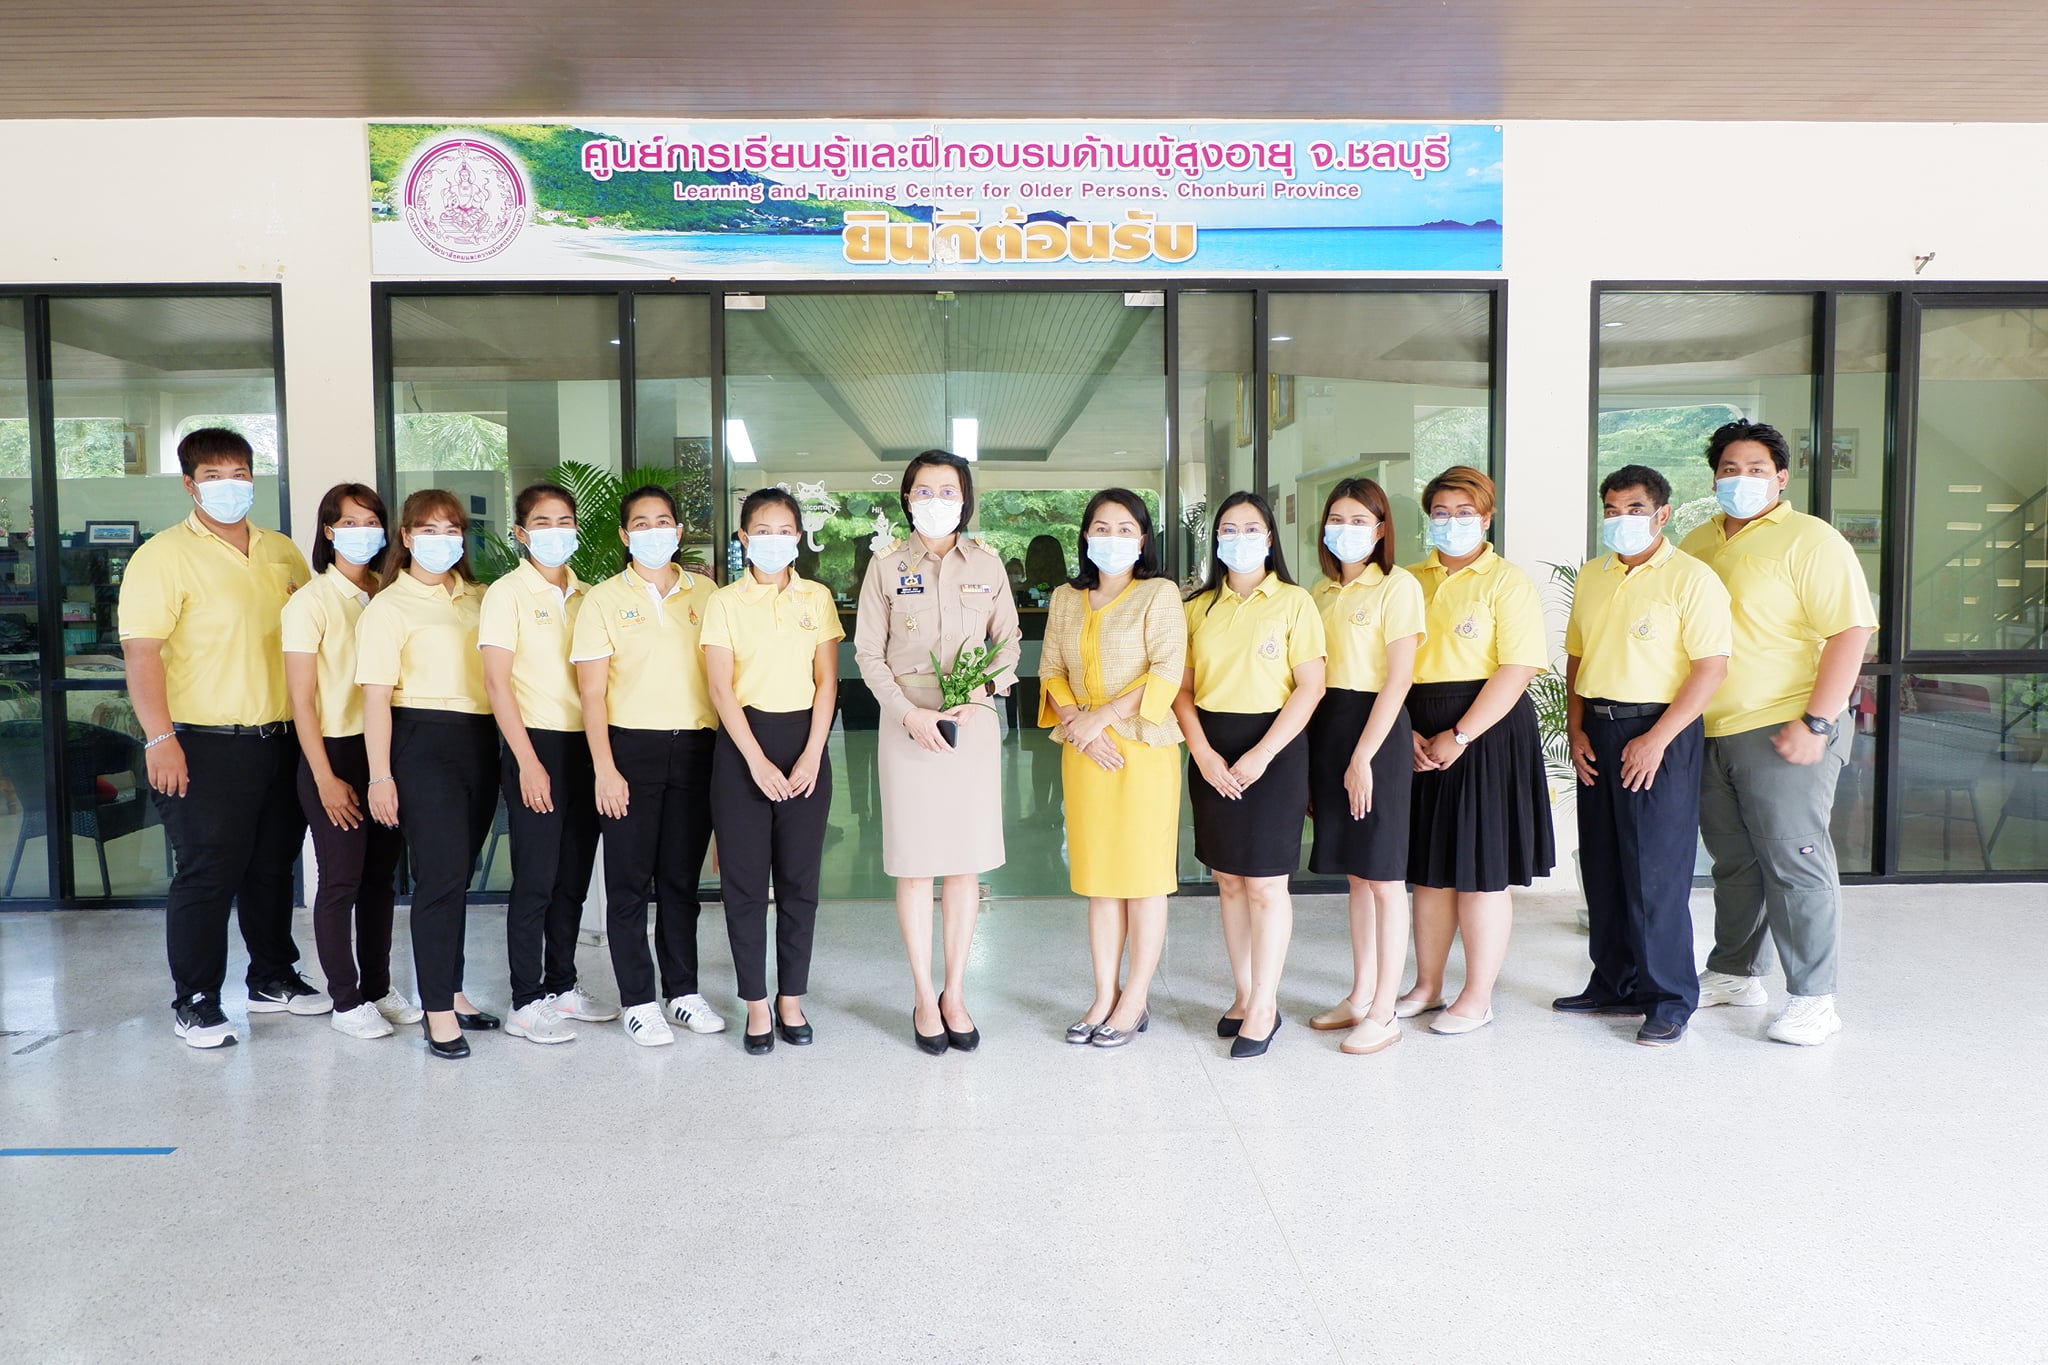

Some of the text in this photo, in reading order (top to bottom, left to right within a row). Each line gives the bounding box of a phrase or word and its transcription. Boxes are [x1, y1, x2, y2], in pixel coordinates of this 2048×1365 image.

[584, 134, 1447, 178] ศูนย์การเรียนรู้และฝึกอบรมด้านผู้สูงอายุ จ.ชลบุรี
[676, 184, 762, 201] Learning
[771, 185, 806, 198] and
[816, 183, 896, 201] Training
[905, 183, 973, 198] Center
[983, 183, 1011, 197] for
[1020, 183, 1072, 197] Older
[1177, 183, 1265, 197] Chonburi
[1274, 183, 1359, 197] Province
[845, 206, 1195, 261] ยินดีต้อนรับ
